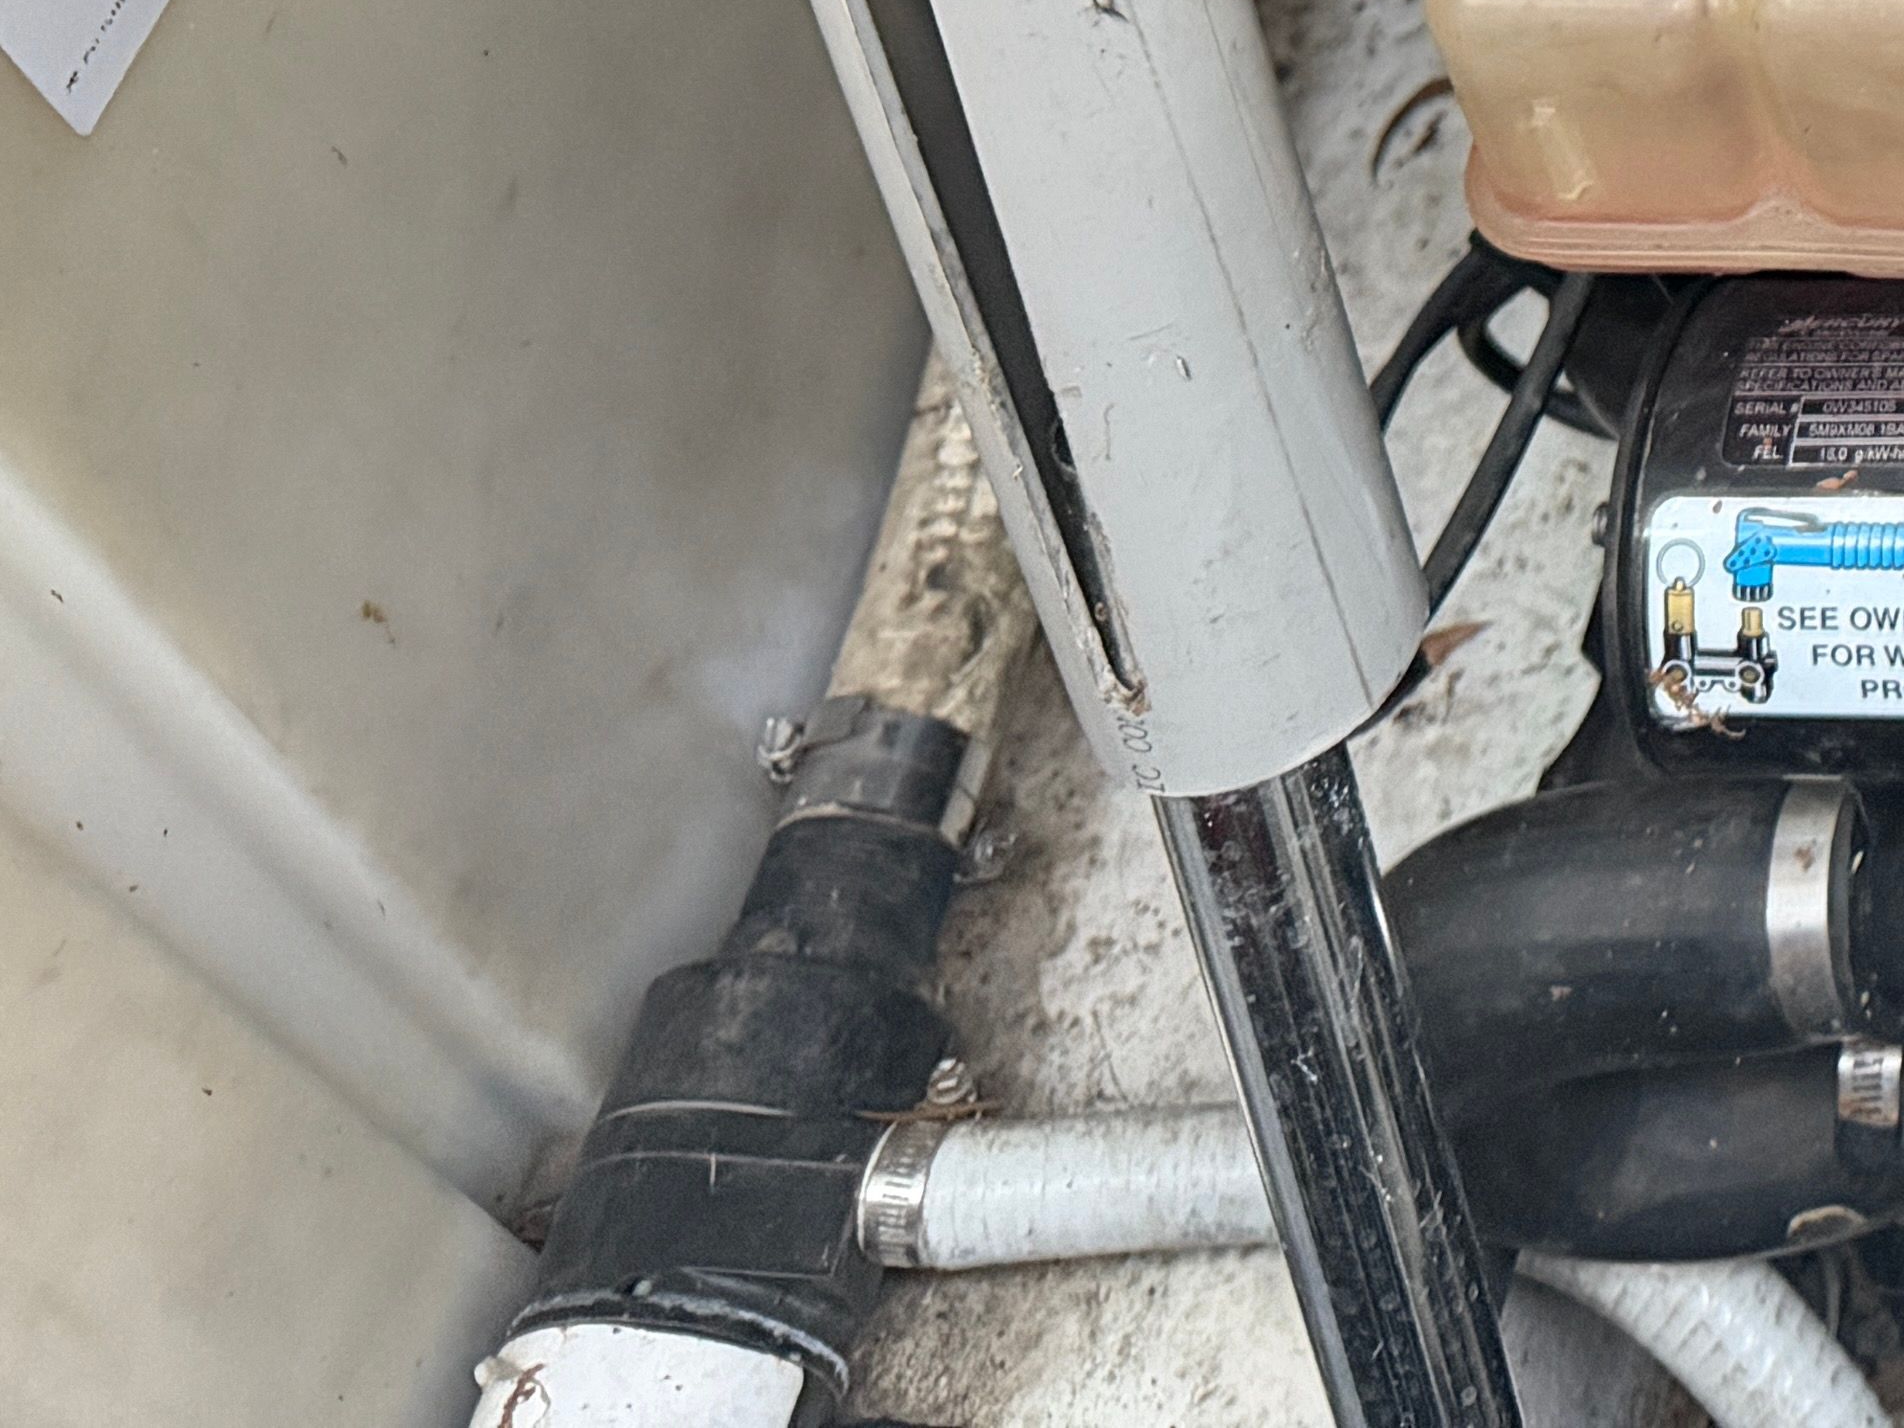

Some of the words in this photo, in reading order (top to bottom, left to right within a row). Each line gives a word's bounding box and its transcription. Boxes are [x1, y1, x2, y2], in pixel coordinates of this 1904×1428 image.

[1738, 368, 1787, 379] REFER
[1793, 368, 1812, 379] TO
[1734, 380, 1850, 391] SPECIFICATIONS
[1854, 380, 1887, 391] AND
[1734, 401, 1787, 415] SERIAL
[1739, 424, 1792, 438] FAMILY
[1776, 606, 1840, 632] SEE
[1810, 644, 1877, 668] FOR
